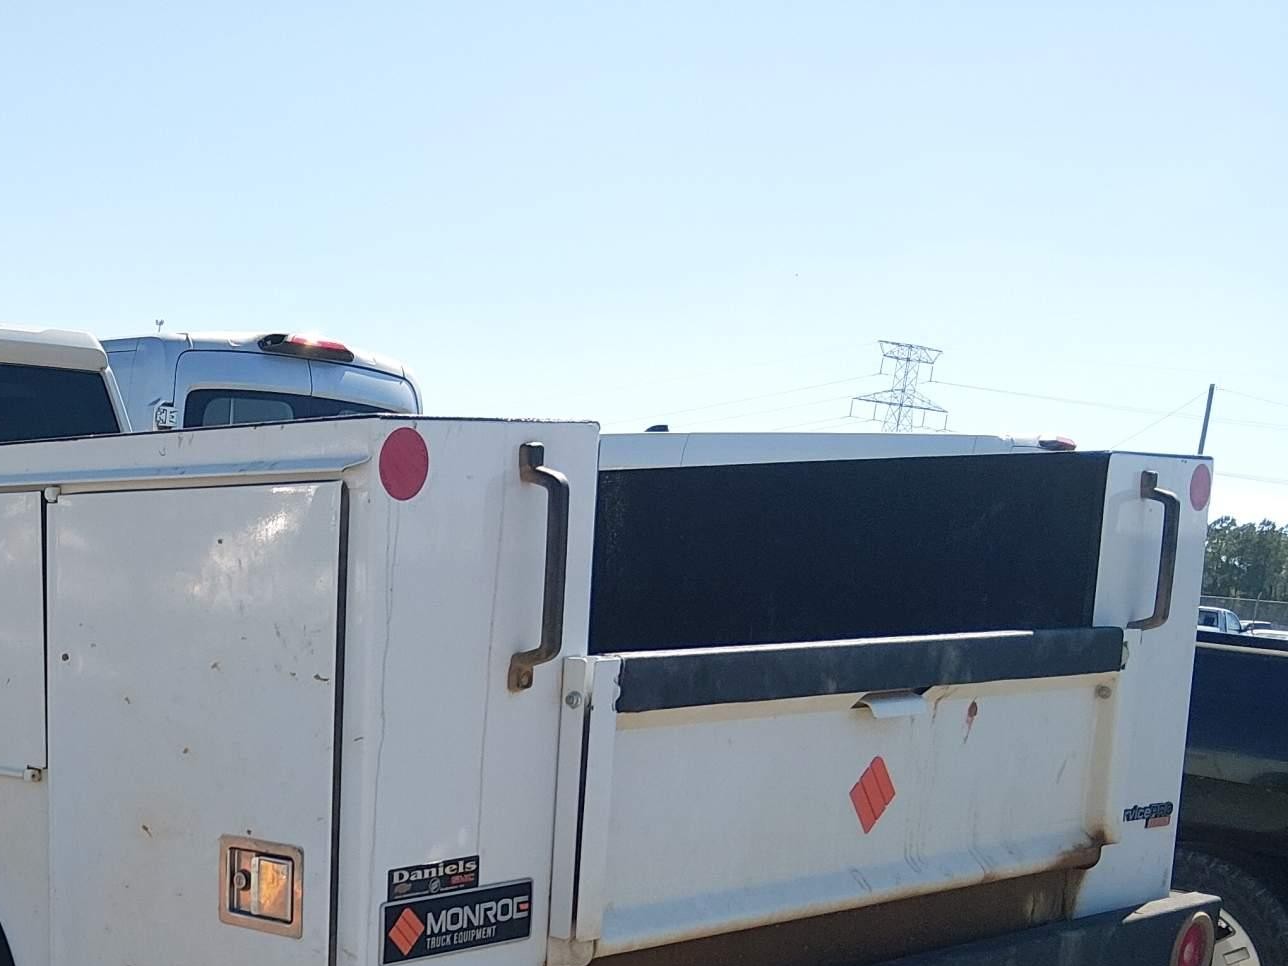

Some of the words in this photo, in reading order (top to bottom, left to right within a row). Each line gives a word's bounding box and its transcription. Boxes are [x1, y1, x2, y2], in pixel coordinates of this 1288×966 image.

[392, 860, 478, 885] Daniels
[426, 895, 529, 936] MONROE
[425, 933, 452, 950] TRUCK
[453, 925, 497, 945] EQUIPMENT
